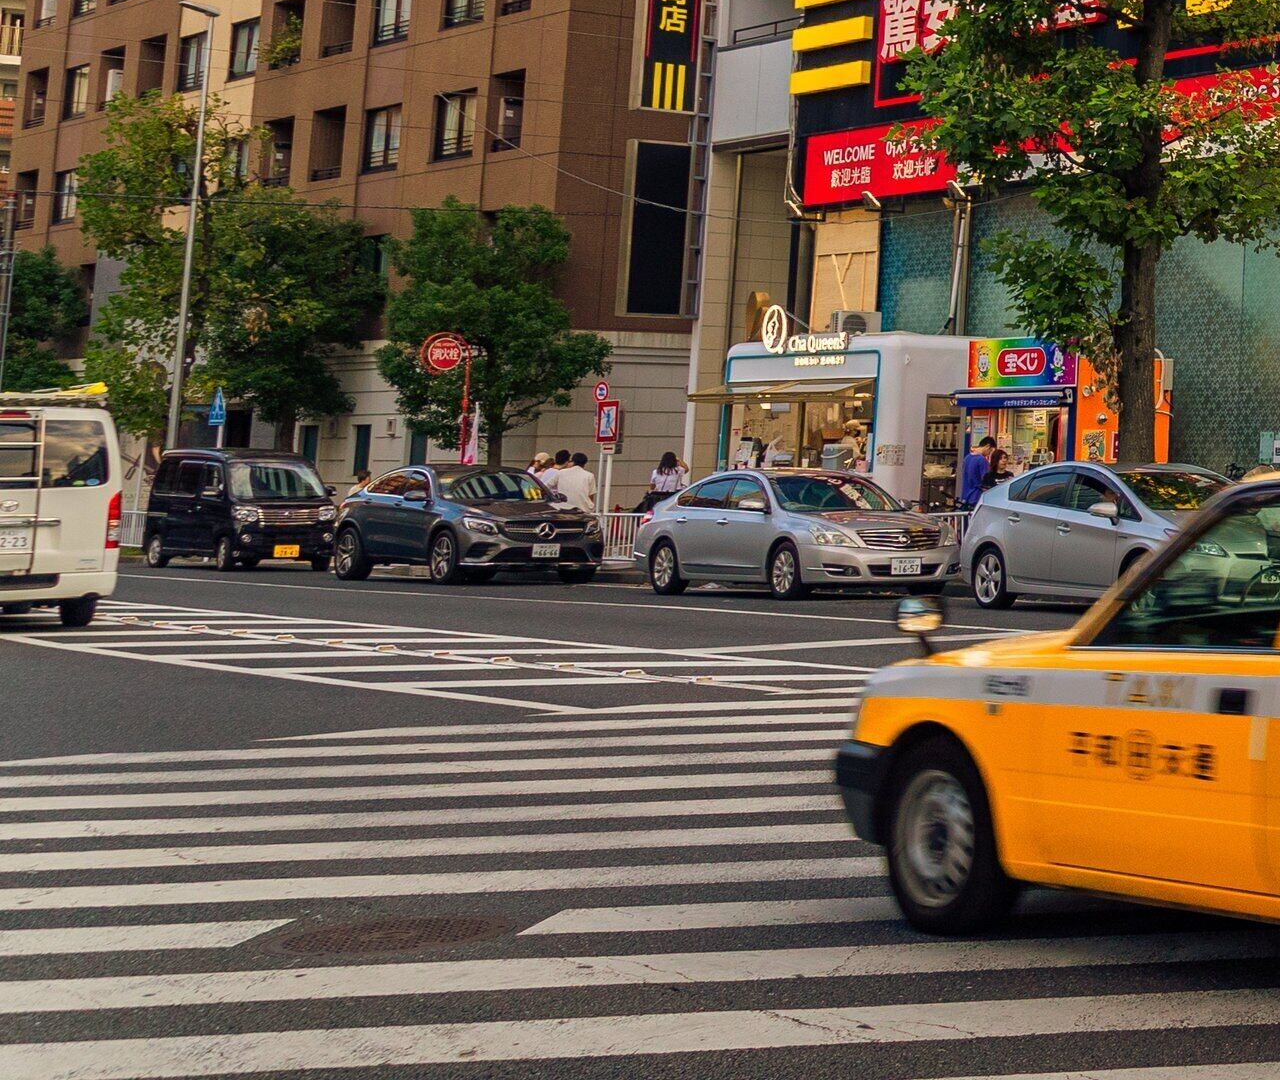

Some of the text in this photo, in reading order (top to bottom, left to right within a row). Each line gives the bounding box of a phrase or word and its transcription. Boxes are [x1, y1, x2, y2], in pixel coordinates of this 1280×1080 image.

[823, 143, 876, 166] WELCOME
[892, 157, 936, 180] 欢迎光临
[431, 348, 460, 360] 消火栓
[788, 335, 807, 352] Cha
[1004, 352, 1038, 373] 宝くじ
